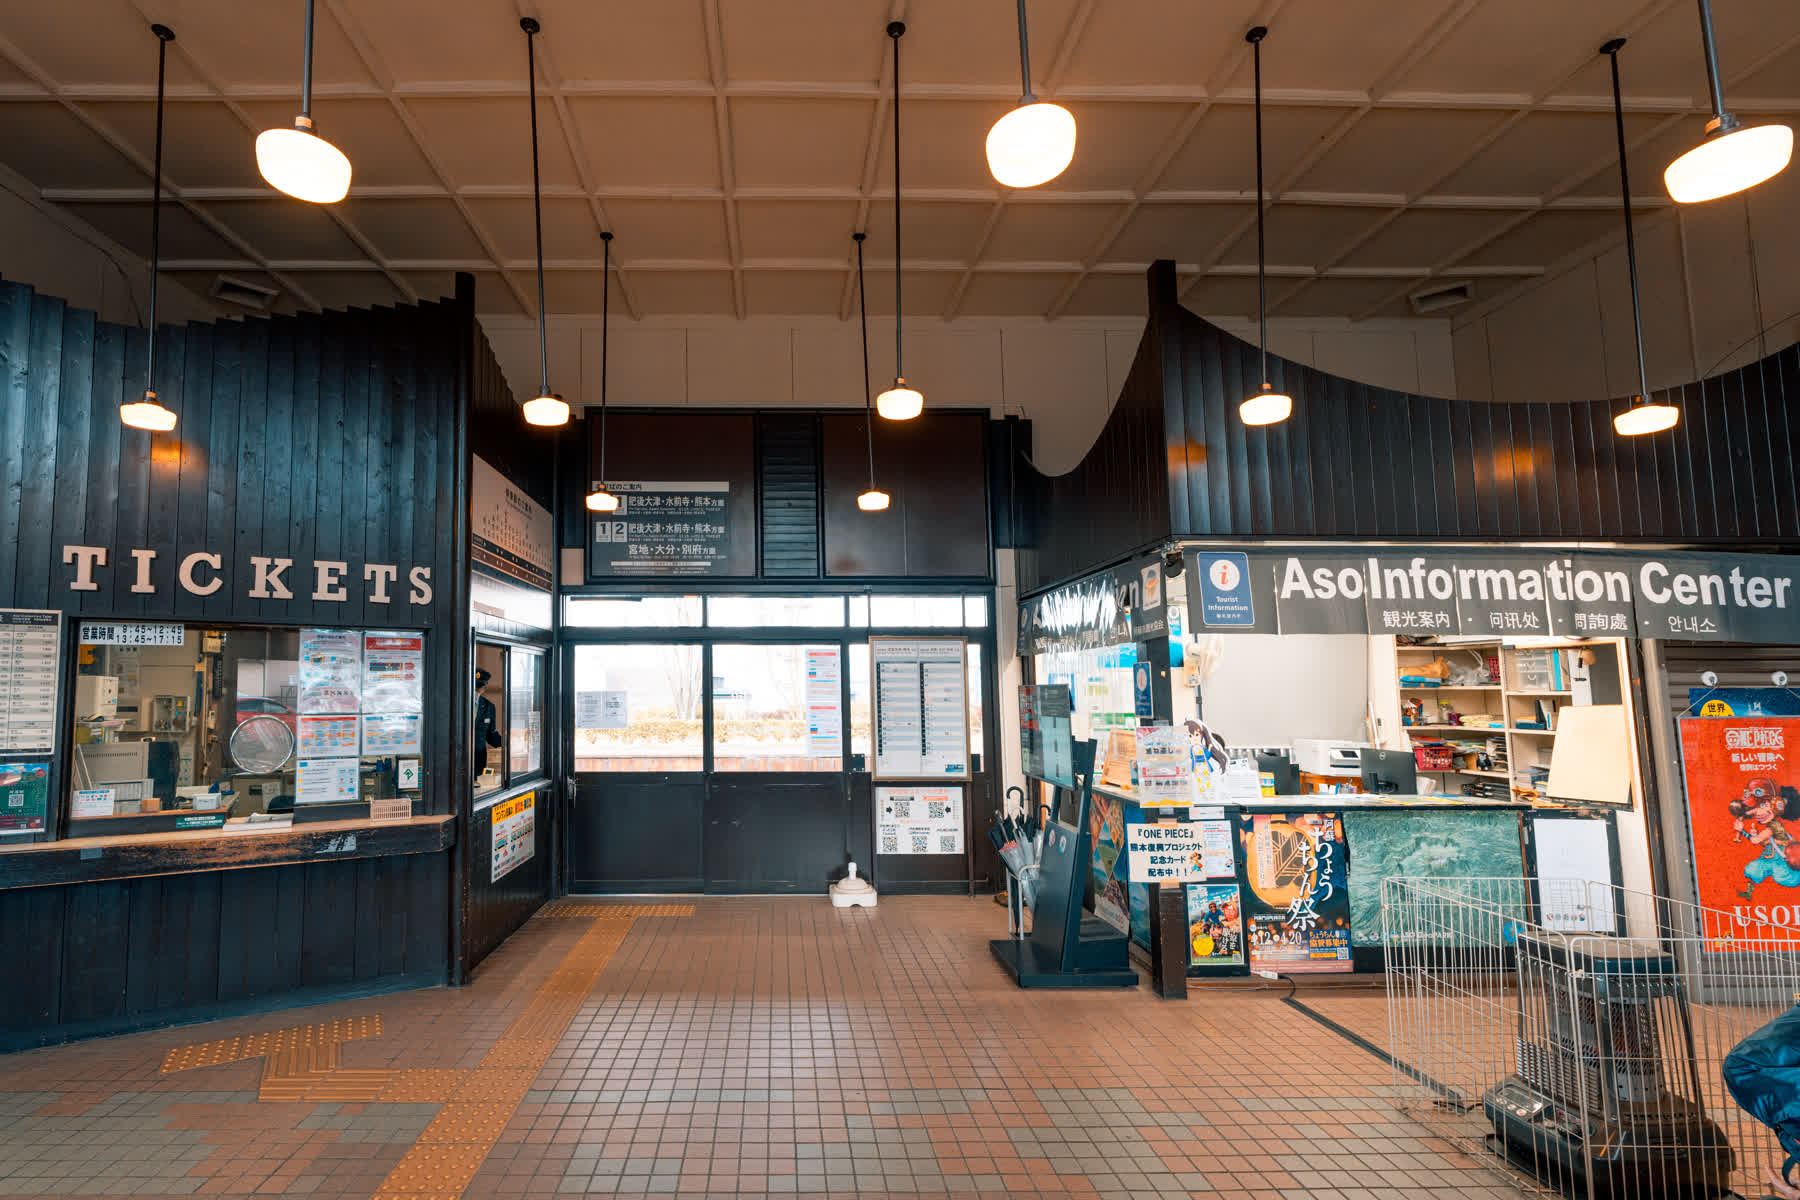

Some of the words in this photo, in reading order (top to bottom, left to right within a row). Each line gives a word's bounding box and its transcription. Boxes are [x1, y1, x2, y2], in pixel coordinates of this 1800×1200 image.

[600, 523, 606, 534] 1
[615, 523, 624, 534] 2
[628, 544, 717, 555] 宮地・大分・別府方面
[63, 545, 433, 605] TICKETS
[1641, 561, 1791, 608] Center
[1207, 604, 1249, 612] Information
[1382, 610, 1451, 629] 観光案内
[1668, 615, 1718, 633] 안내소
[82, 626, 115, 641] 営業時間
[1707, 703, 1725, 713] 世界
[1731, 752, 1785, 763] 新しい冒険へ
[1324, 819, 1335, 841] 阿蘇
[1130, 843, 1202, 852] 熊本復興プロジェクト
[1150, 856, 1186, 864] 記念カード
